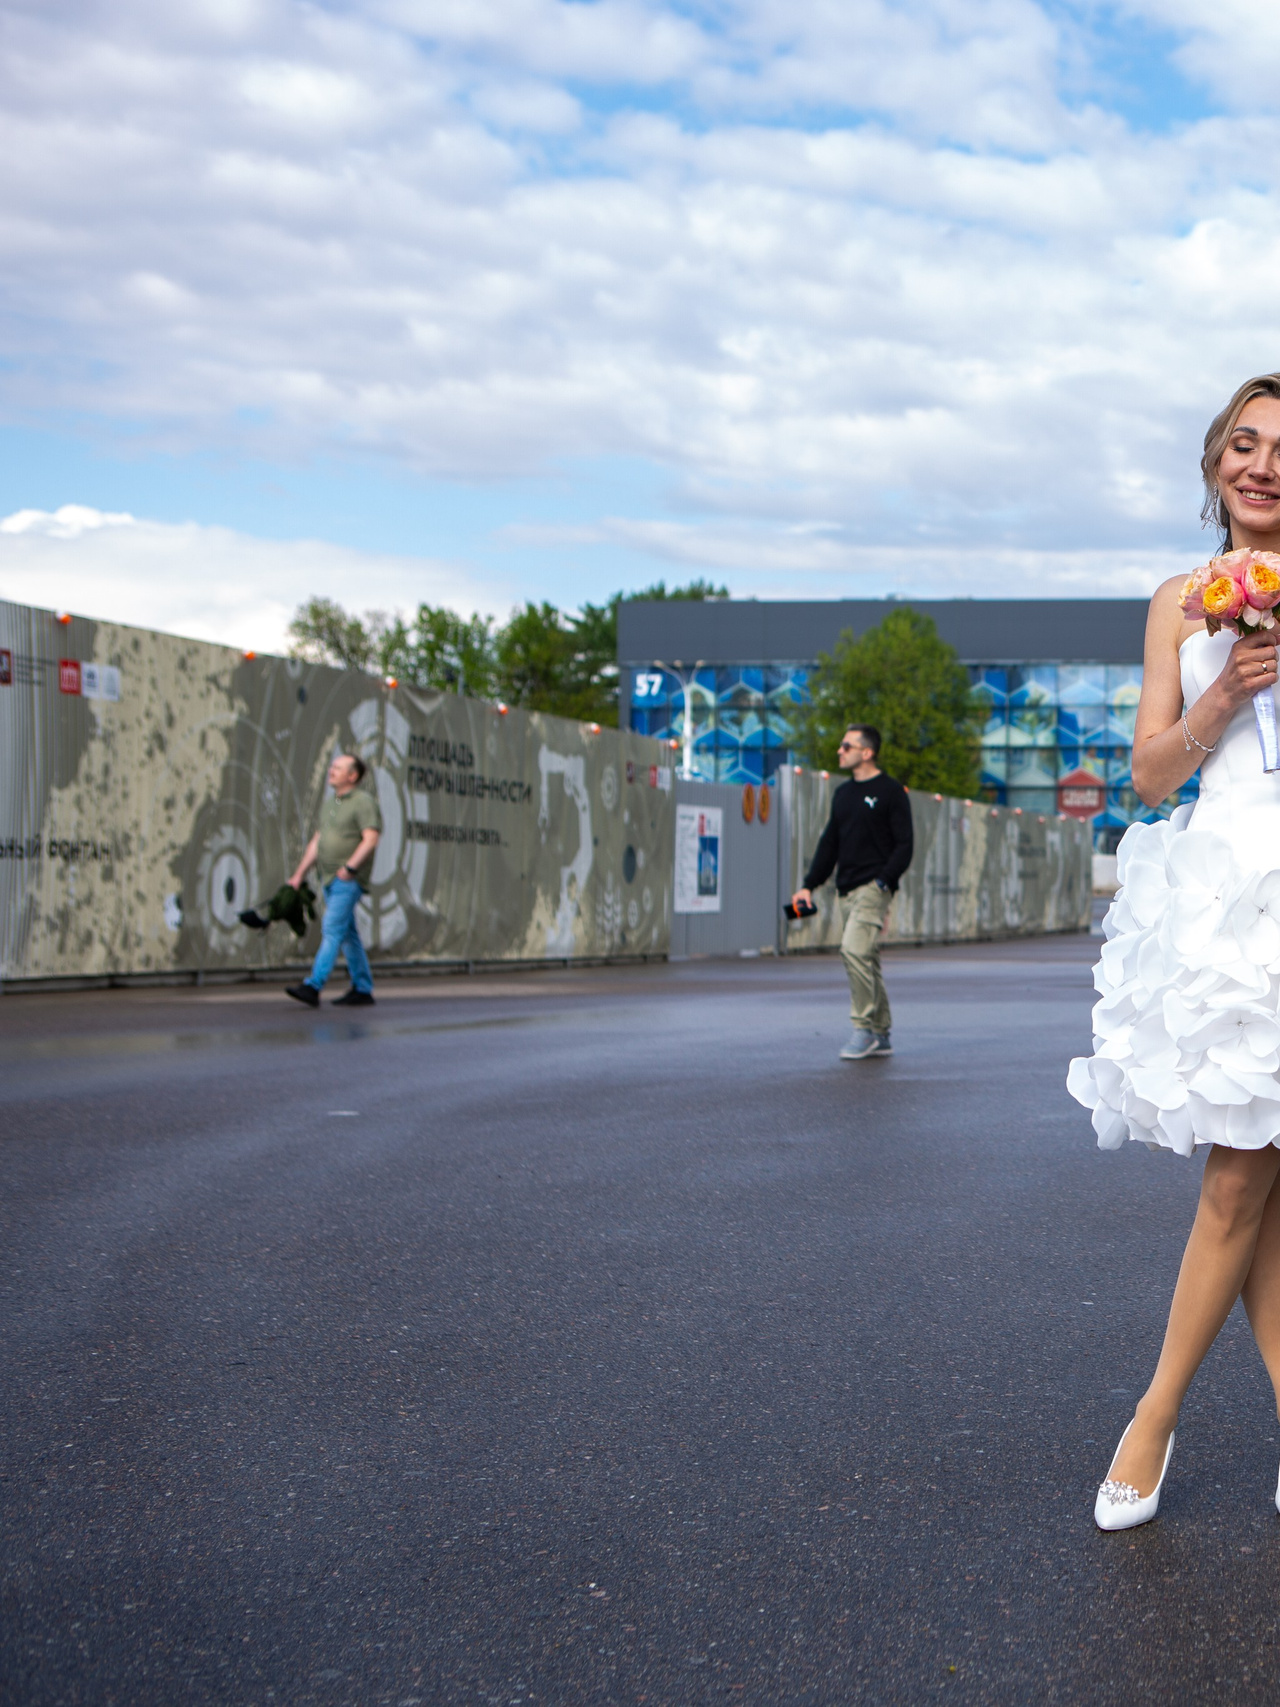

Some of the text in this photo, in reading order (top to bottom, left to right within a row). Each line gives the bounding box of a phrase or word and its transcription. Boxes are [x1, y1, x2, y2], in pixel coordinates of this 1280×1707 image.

[635, 673, 663, 697] 57
[408, 734, 475, 768] ПЛОЩАДЬ
[407, 765, 533, 803] ПРОМЫШЛЕННОСТИ
